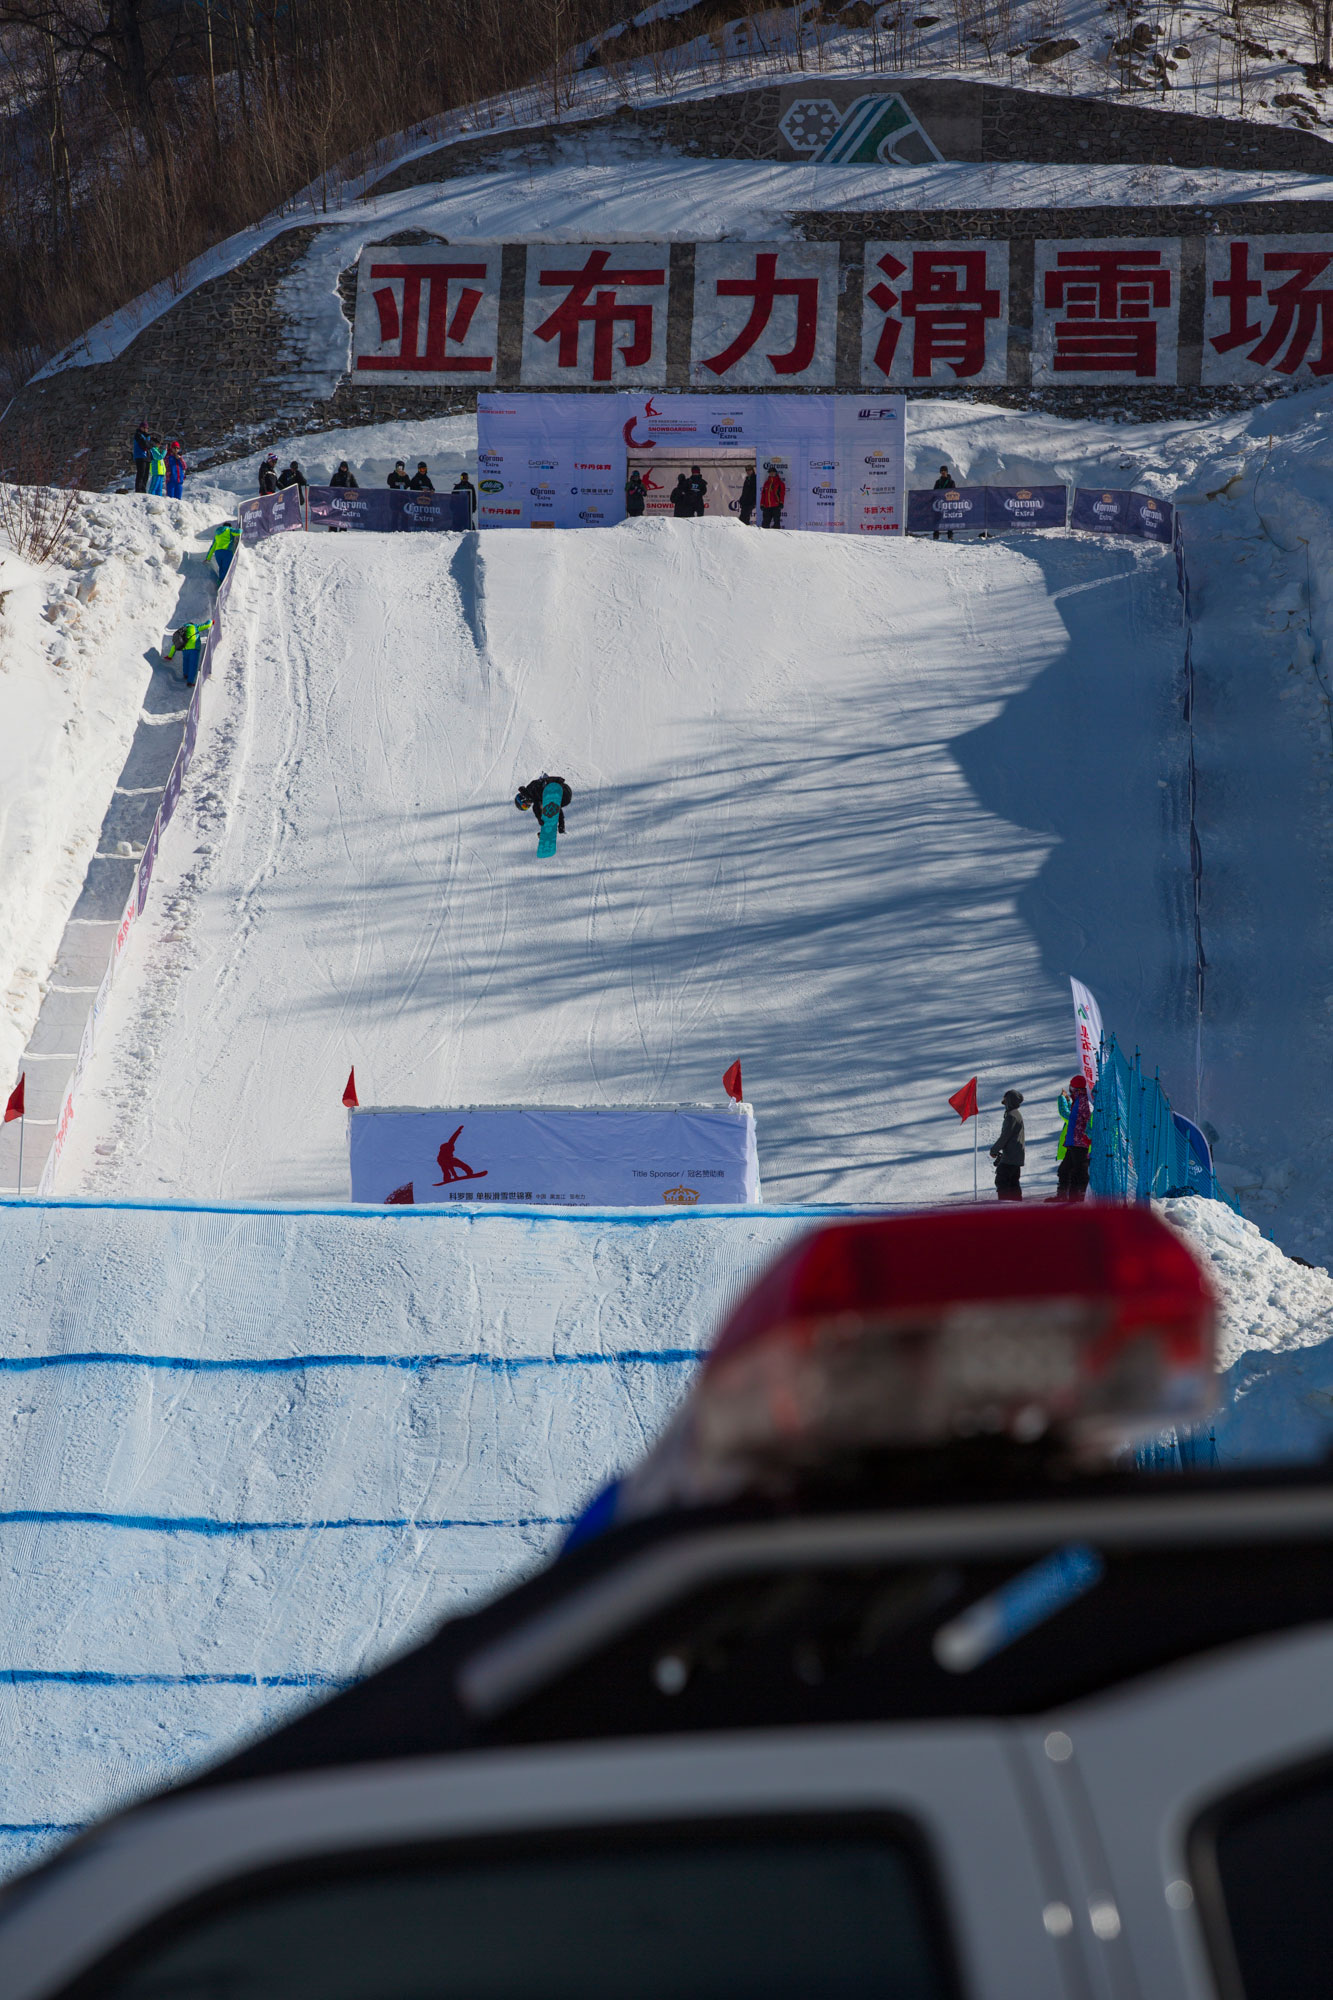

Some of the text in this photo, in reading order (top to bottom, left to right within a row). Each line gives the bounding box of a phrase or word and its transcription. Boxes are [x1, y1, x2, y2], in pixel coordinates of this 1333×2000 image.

[357, 242, 1333, 381] 亚布力滑雪场
[858, 409, 891, 418] WSF
[711, 425, 744, 435] Corona
[478, 455, 504, 463] Corona
[864, 456, 890, 464] Corona
[530, 488, 556, 496] Corona
[812, 487, 838, 495] Corona
[331, 498, 367, 511] Corona
[403, 502, 441, 515] Corona
[932, 499, 973, 512] Corona
[1004, 498, 1045, 511] Corona
[1093, 502, 1120, 515] Corona
[341, 509, 361, 518] Extra
[413, 513, 434, 522] Extra
[578, 512, 604, 520] Corona
[1140, 506, 1163, 522] Corona
[649, 1170, 680, 1179] Sponsor
[687, 1170, 725, 1178] 冠名赞助商
[476, 1192, 533, 1200] 单板滑雪世锦赛
